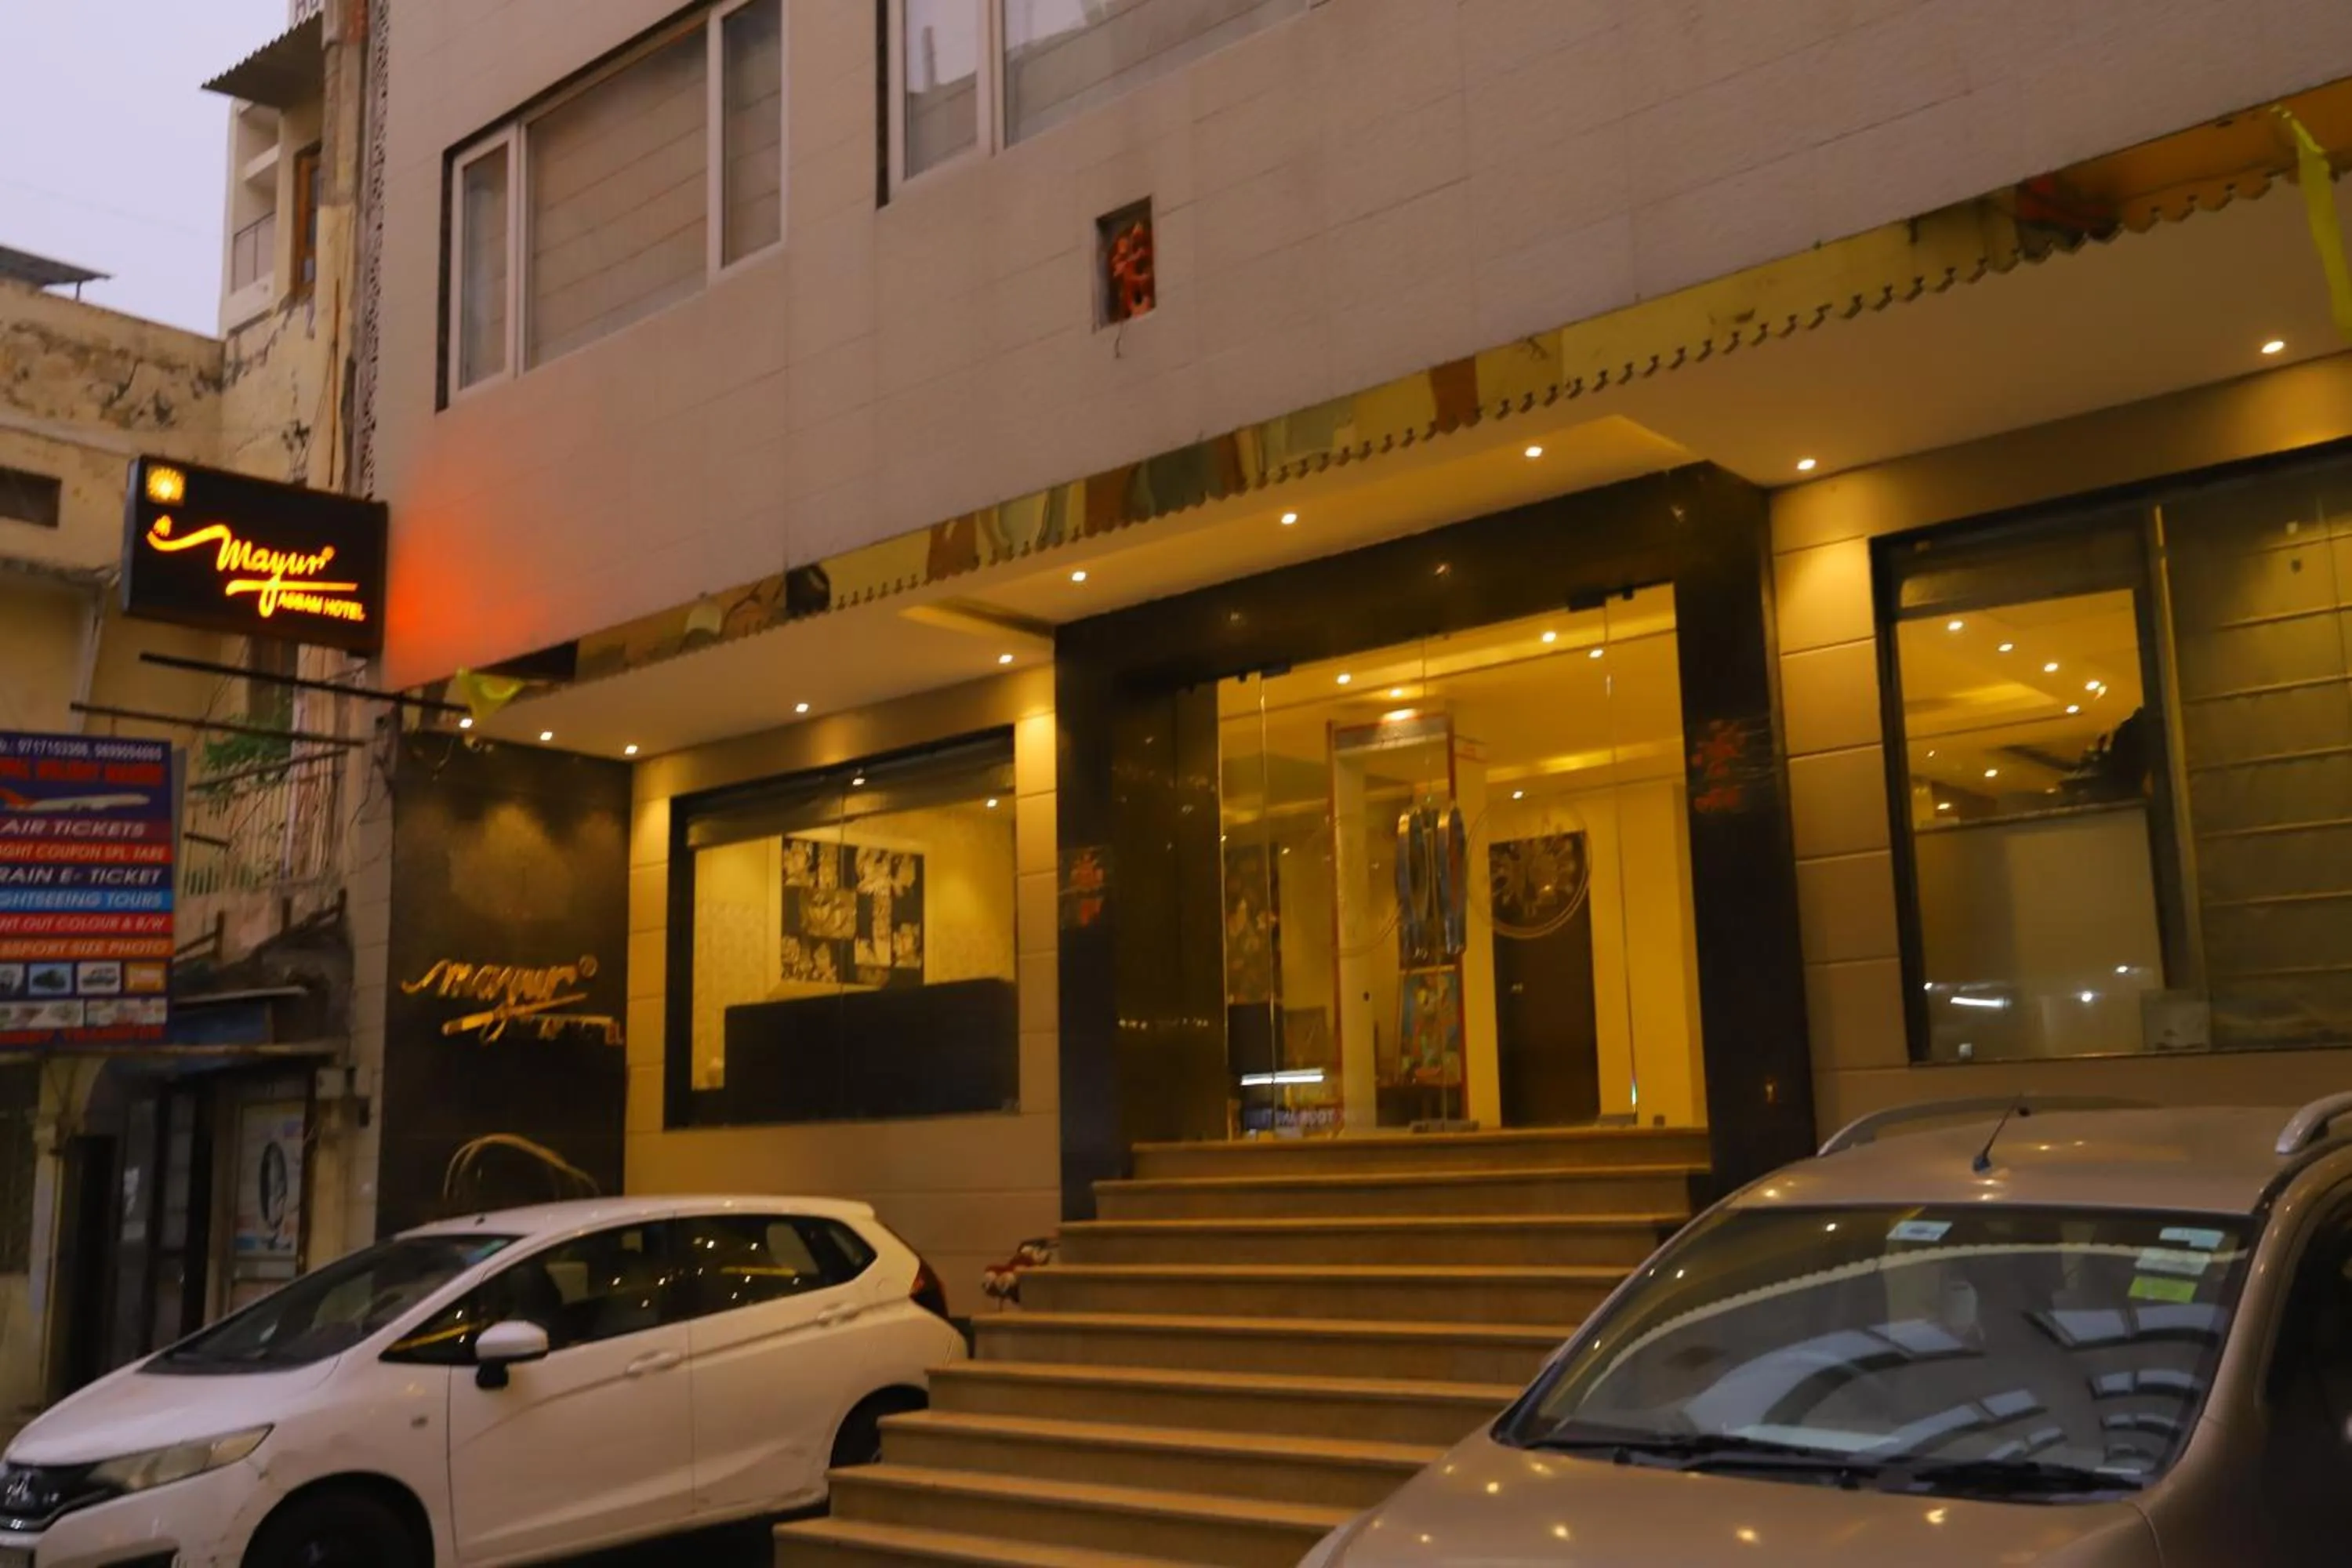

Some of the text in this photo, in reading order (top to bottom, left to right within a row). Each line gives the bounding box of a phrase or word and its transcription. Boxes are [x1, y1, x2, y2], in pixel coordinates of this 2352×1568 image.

[323, 598, 365, 621] HOTEL
[1, 818, 146, 838] AIR TICKETS
[90, 867, 162, 887] TICKET
[107, 891, 162, 909] TOURS
[56, 914, 120, 932] COLOUR
[109, 939, 168, 956] PHOTO
